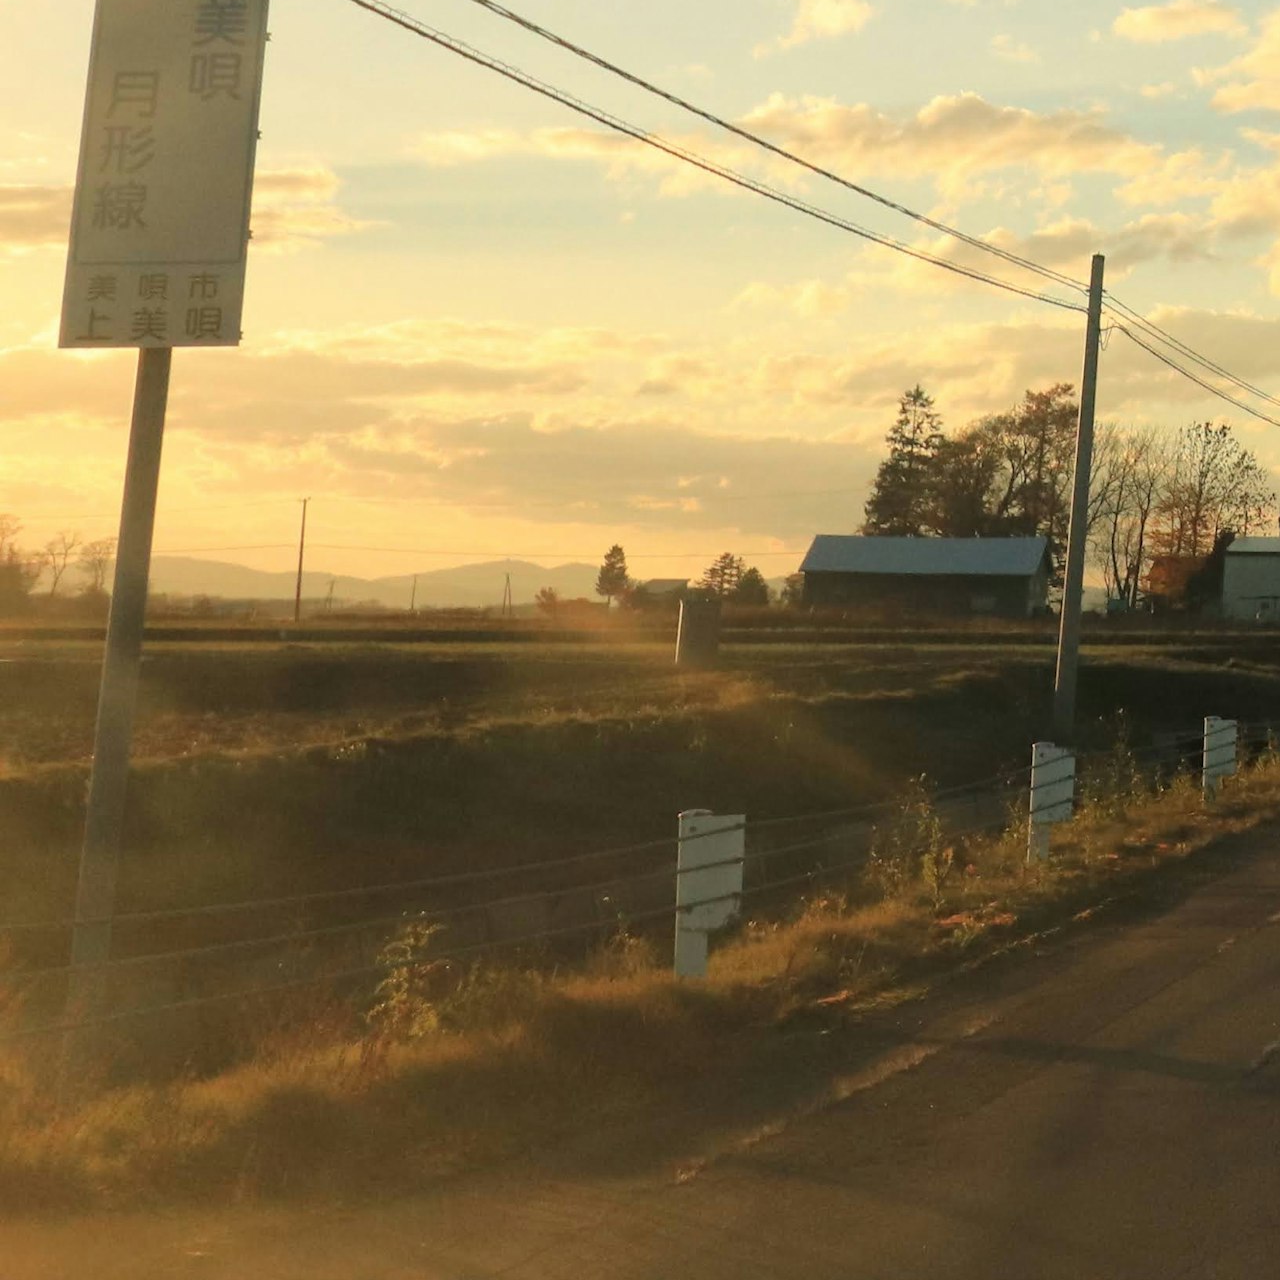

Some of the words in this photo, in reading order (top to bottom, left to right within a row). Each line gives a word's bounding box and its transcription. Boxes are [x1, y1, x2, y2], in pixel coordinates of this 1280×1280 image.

[91, 69, 161, 230] 月形線
[86, 271, 221, 302] 美唄市
[74, 306, 222, 341] 上美唄
